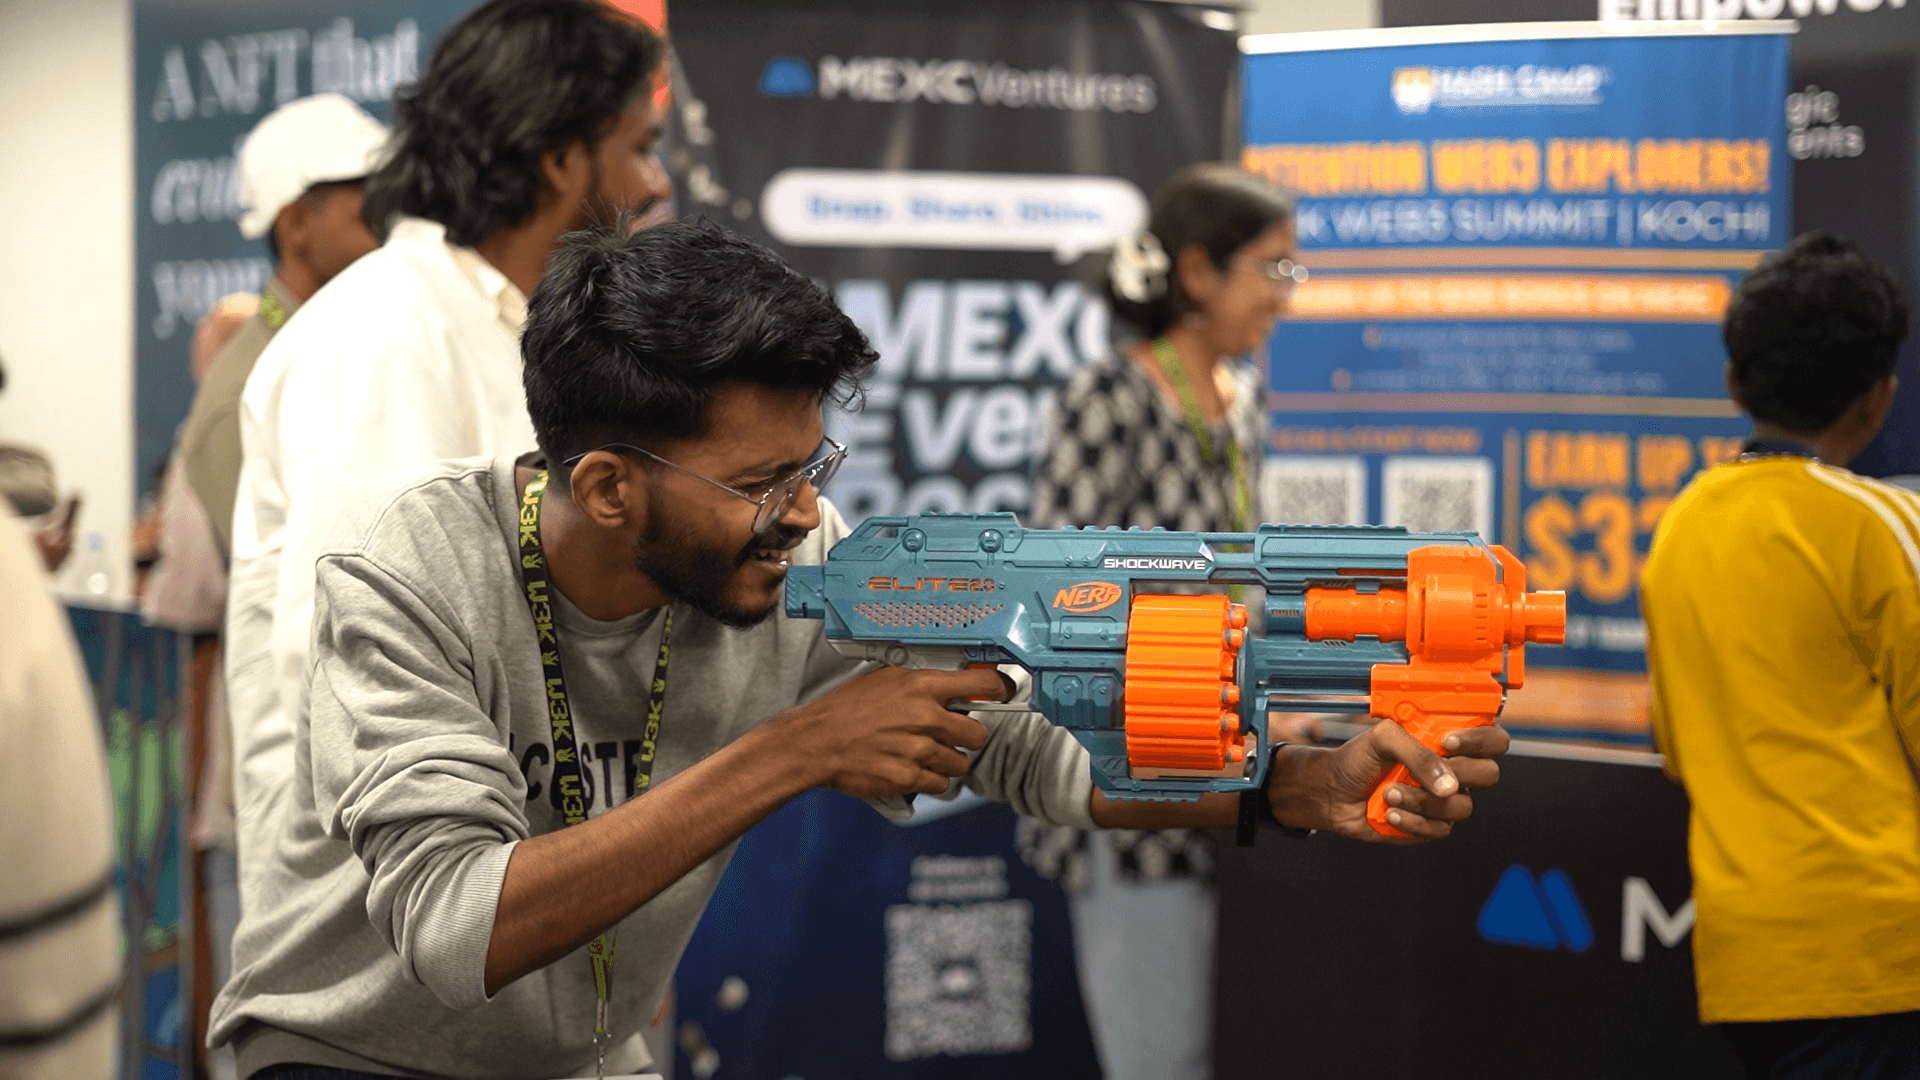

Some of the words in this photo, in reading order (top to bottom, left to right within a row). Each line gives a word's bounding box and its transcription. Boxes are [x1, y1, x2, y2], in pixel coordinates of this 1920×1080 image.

[1597, 0, 1908, 20] Empo
[819, 55, 976, 104] MEXC
[974, 63, 1157, 113] Ventures
[1331, 199, 1449, 242] WEB3
[1452, 198, 1613, 243] SUMMIT
[1638, 199, 1771, 242] KOCHI
[1526, 431, 1631, 490] EARN
[1637, 433, 1694, 492] UP
[1103, 558, 1206, 570] SHOCKWAVE
[1525, 494, 1676, 604] $3
[868, 576, 969, 592] ELITE
[1052, 584, 1119, 609] NERF
[547, 678, 573, 742] W3K
